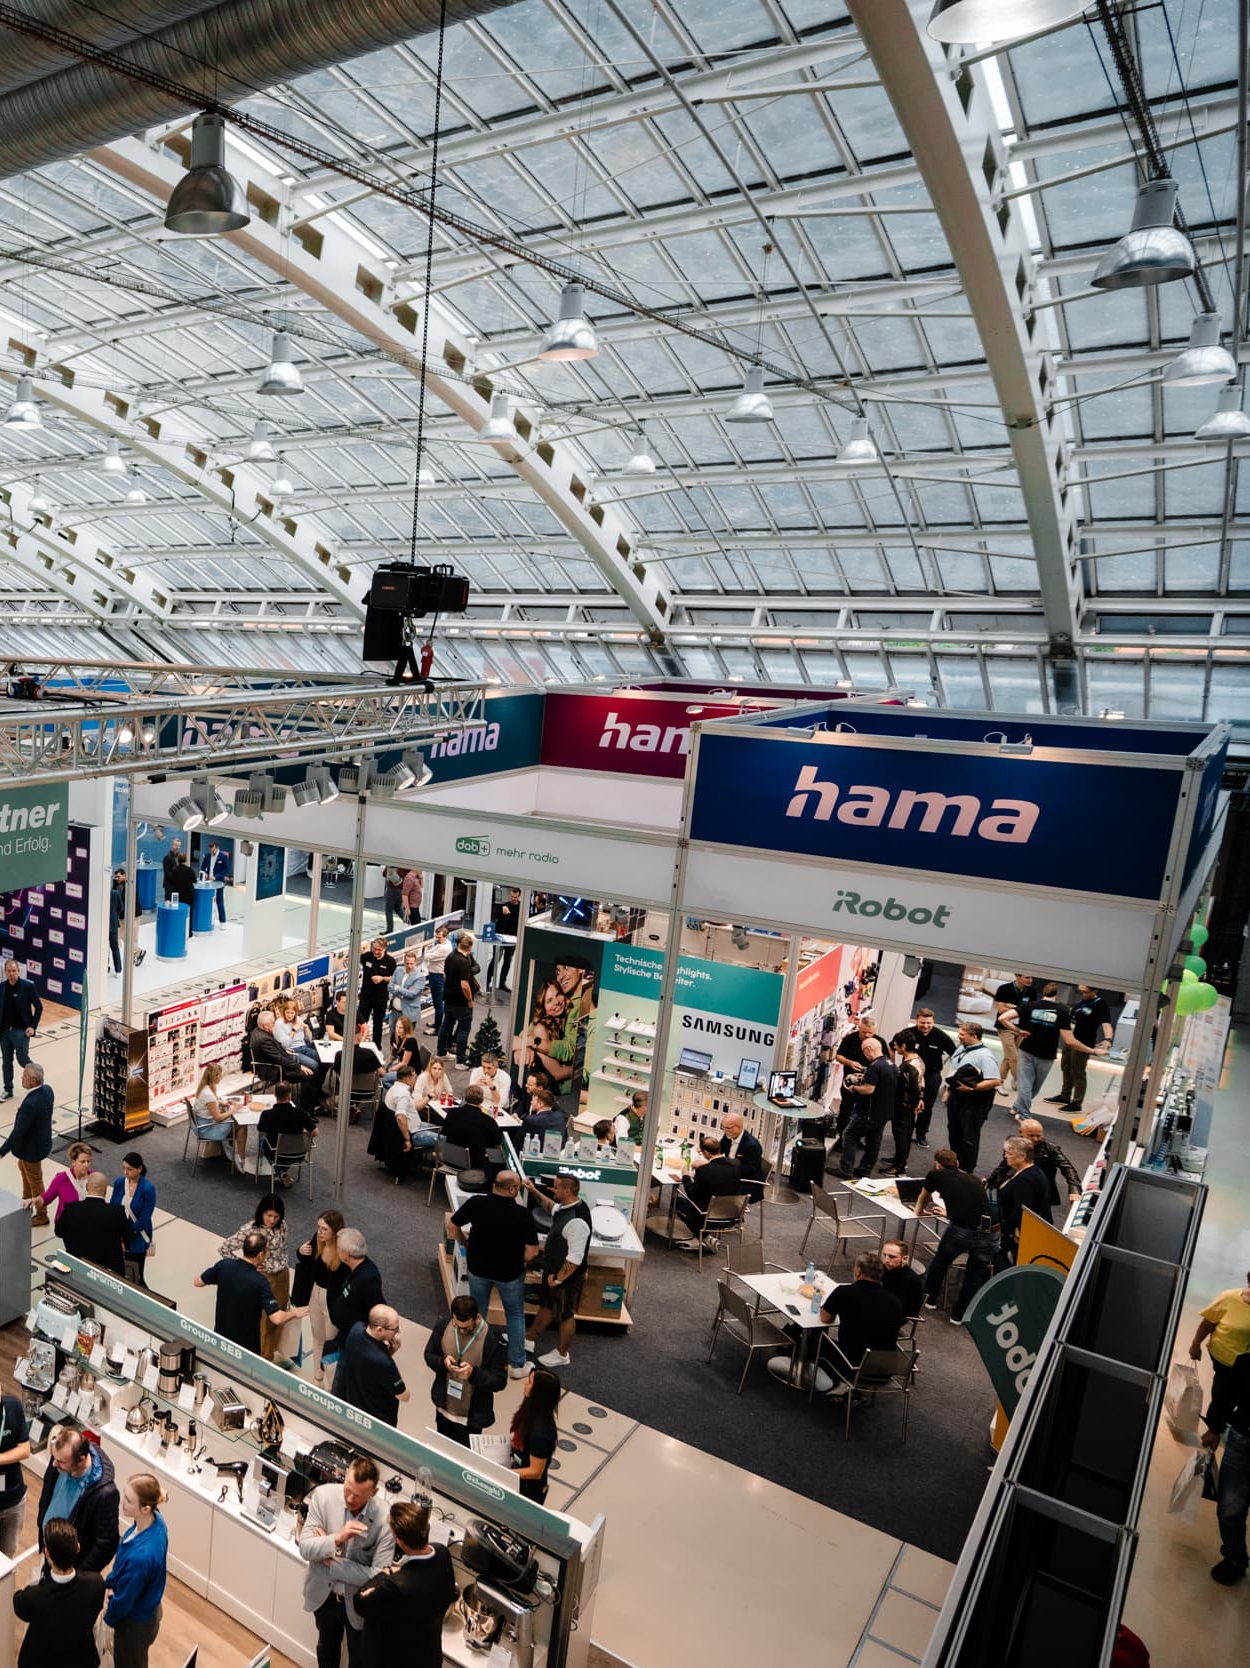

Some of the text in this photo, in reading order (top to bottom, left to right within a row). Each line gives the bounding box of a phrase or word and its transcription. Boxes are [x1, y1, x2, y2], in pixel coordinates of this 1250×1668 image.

[786, 766, 1040, 843] hama
[15, 836, 52, 855] Erfolg.
[496, 847, 526, 858] mehr
[529, 853, 559, 864] radio
[831, 889, 952, 929] iRobot
[614, 963, 652, 979] Stylische
[615, 953, 663, 969] Technische
[682, 1014, 775, 1047] SAMSUNG
[180, 1319, 243, 1360] Groupe SEB
[298, 1383, 374, 1430] Groupe SEB
